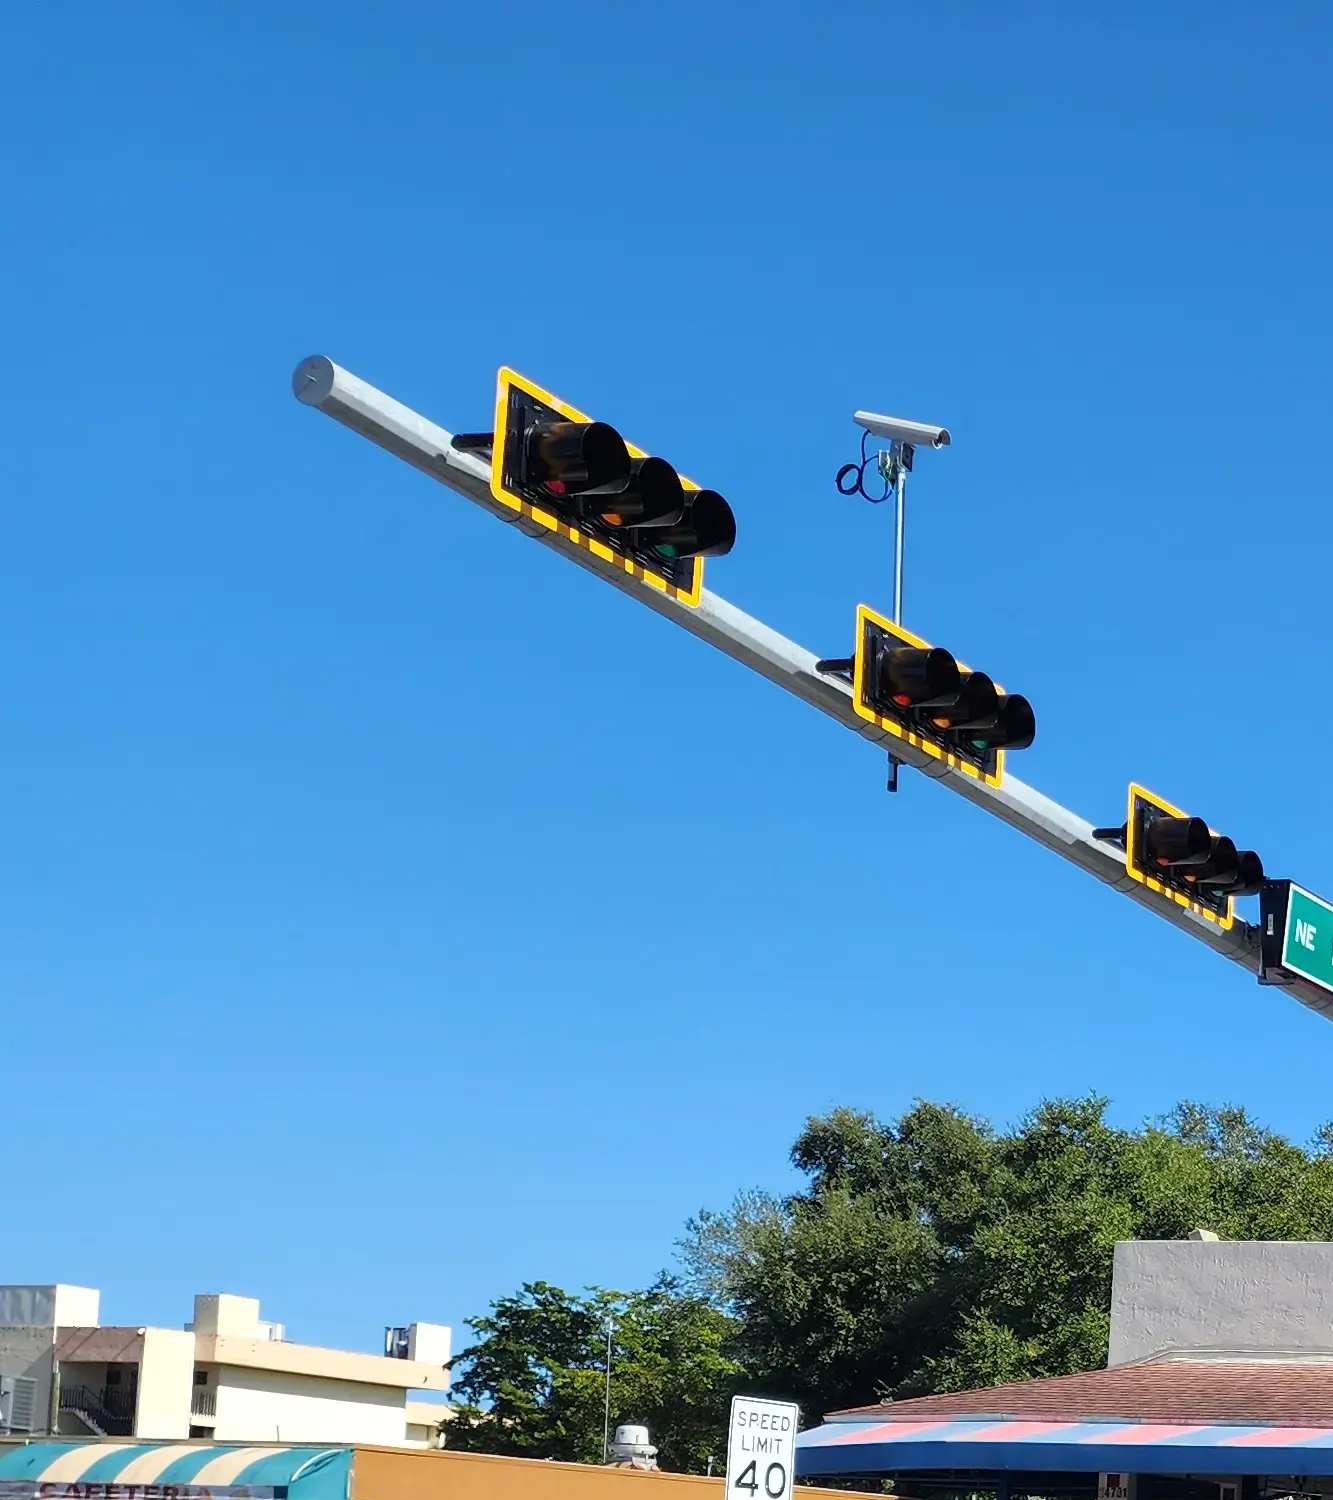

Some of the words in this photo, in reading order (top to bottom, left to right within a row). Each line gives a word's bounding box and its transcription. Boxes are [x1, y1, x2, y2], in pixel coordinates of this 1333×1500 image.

[1295, 918, 1317, 951] NE
[737, 1410, 790, 1432] SPEED
[741, 1435, 783, 1454] LIMIT
[734, 1459, 787, 1499] 40
